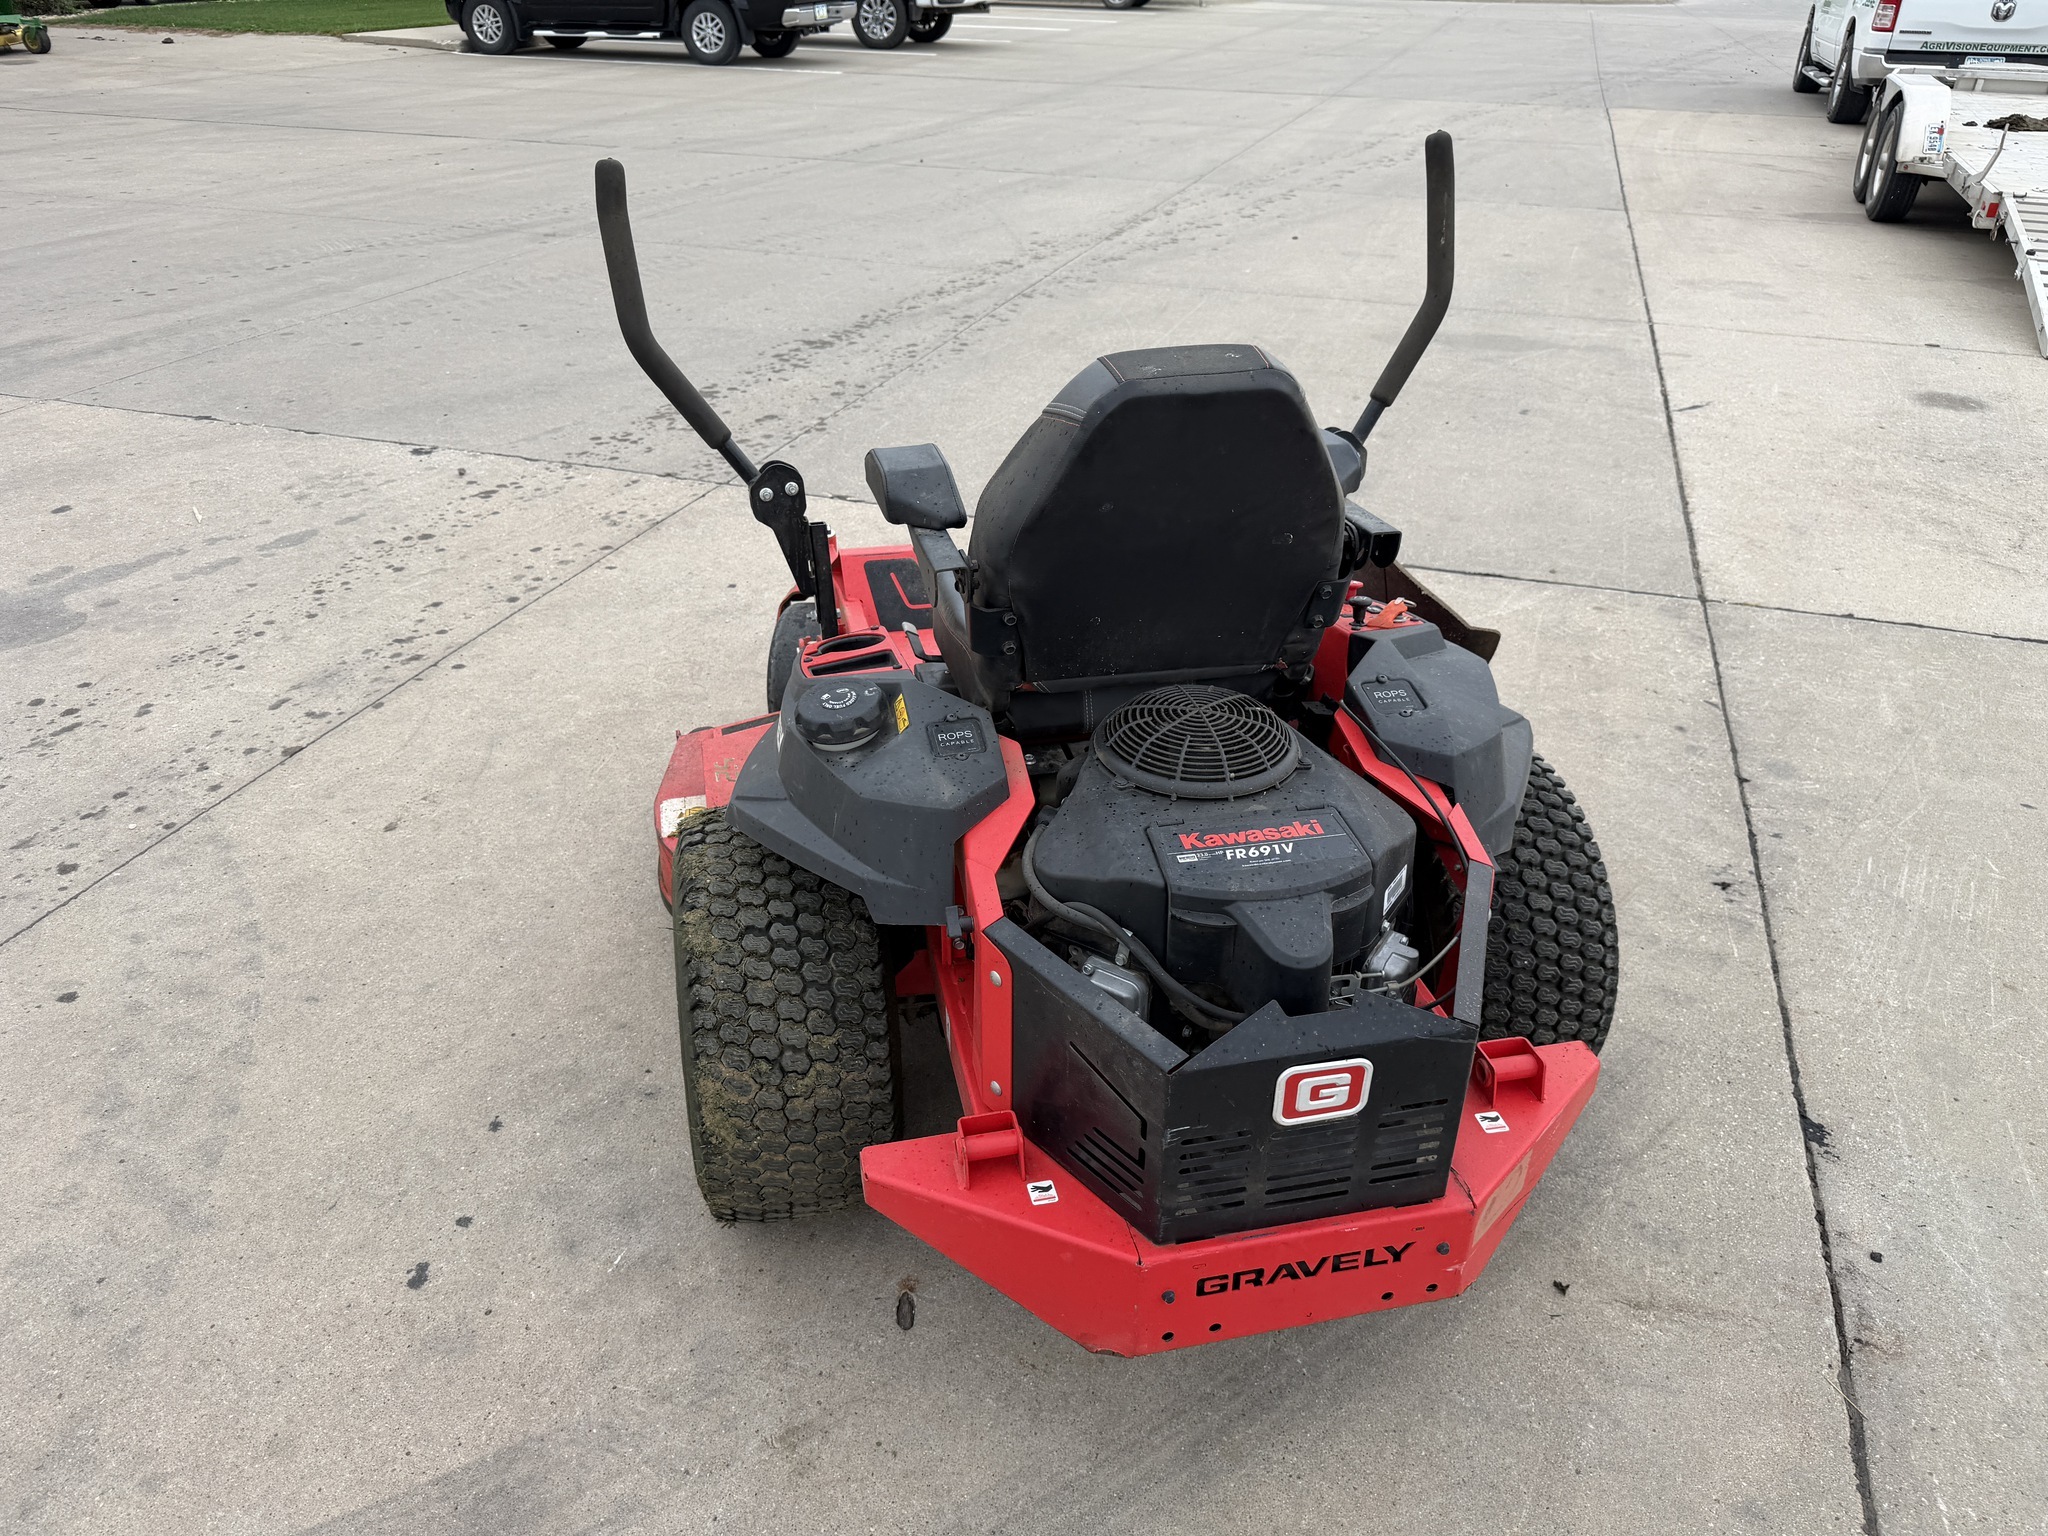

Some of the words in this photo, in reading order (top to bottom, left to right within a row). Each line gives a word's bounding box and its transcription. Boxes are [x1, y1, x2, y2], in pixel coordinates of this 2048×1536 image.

[1920, 41, 2048, 53] AGRIVISIONEQUIPMENT.C
[1373, 689, 1407, 699] ROPS
[937, 730, 973, 742] ROPS
[940, 739, 975, 747] CAPABLE
[1178, 819, 1325, 850] Kawasaki
[1225, 843, 1294, 861] FR691V
[1196, 1241, 1417, 1298] GRAVELY
